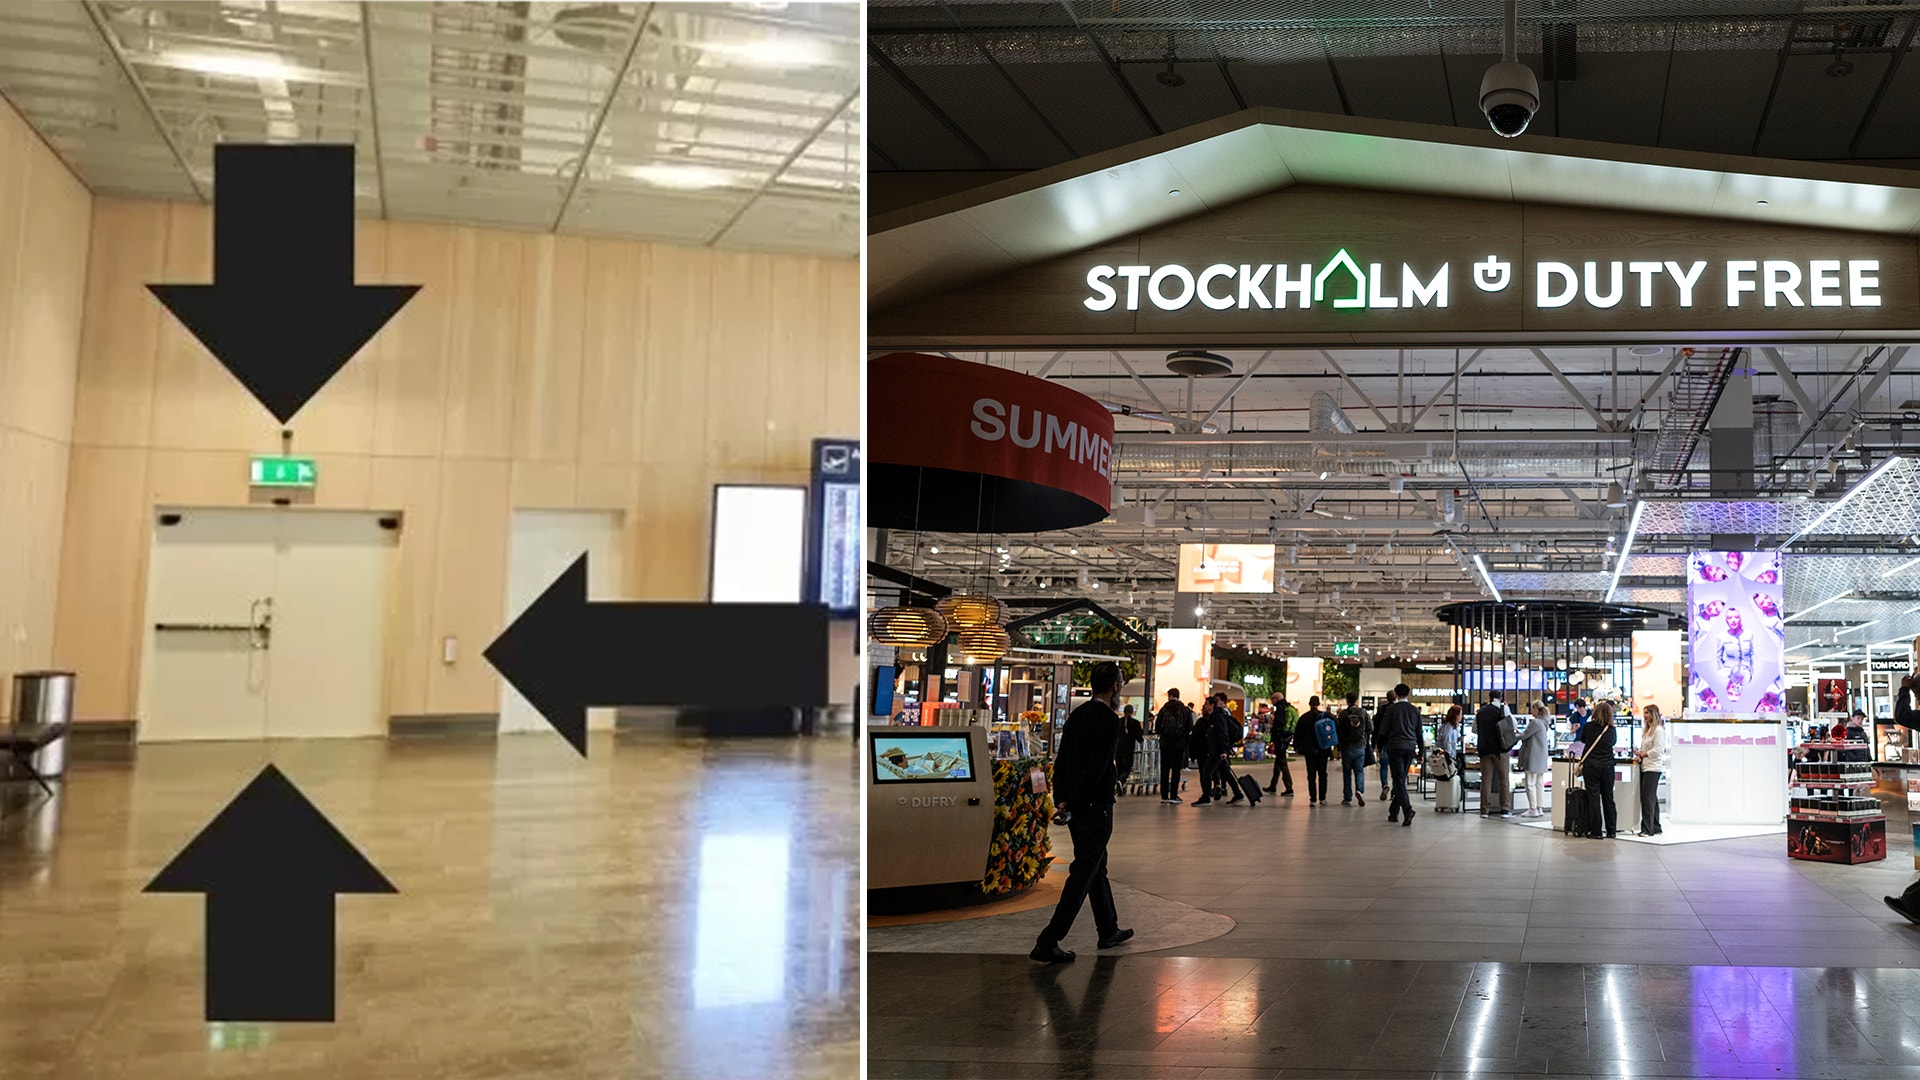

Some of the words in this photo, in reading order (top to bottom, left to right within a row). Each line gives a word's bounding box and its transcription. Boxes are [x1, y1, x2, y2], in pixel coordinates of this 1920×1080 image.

[1536, 260, 1708, 309] DUTY
[1726, 259, 1882, 308] FREE
[1871, 661, 1887, 670] TOM
[1888, 661, 1909, 670] FORD
[911, 796, 957, 808] DUFRY
